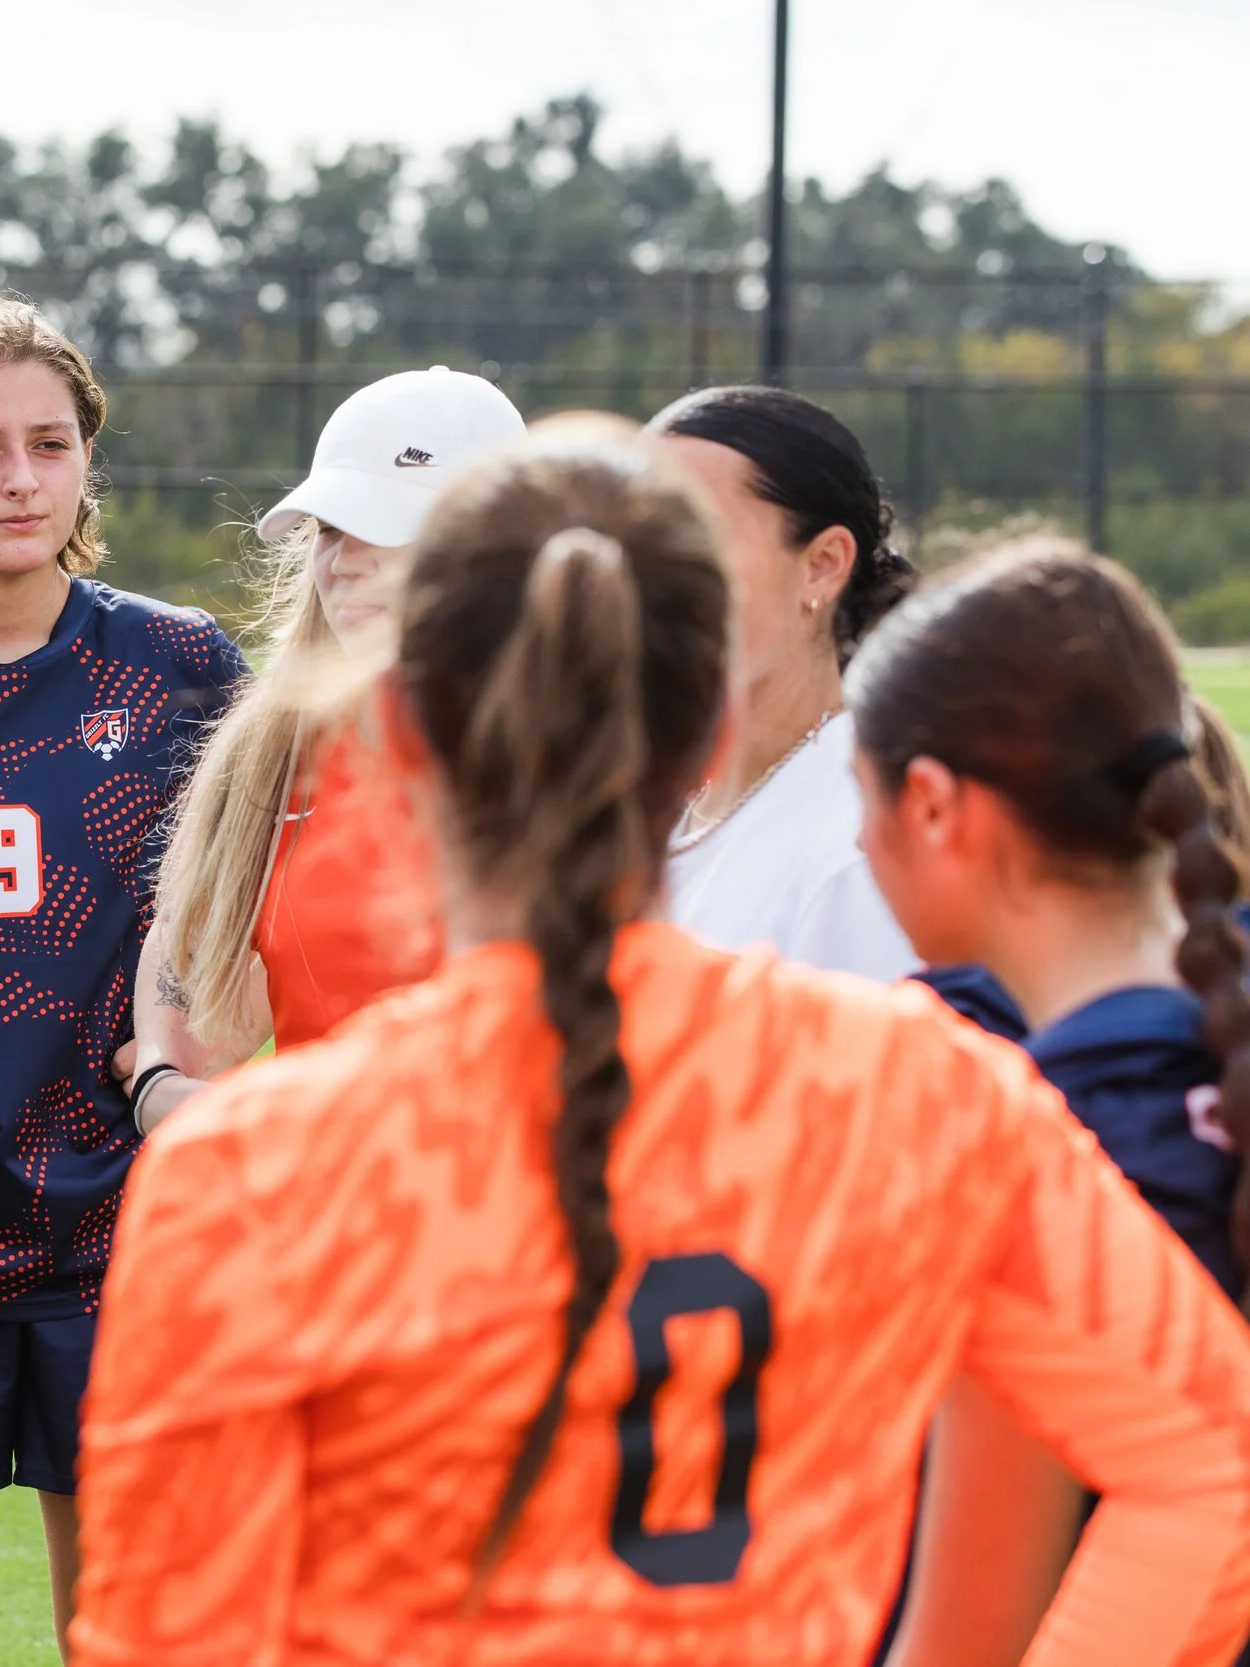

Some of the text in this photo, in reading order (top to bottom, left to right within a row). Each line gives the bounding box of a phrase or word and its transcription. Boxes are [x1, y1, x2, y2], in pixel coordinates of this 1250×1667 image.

[402, 446, 434, 464] NIKE
[107, 719, 122, 743] G
[609, 1251, 772, 1588] 0
